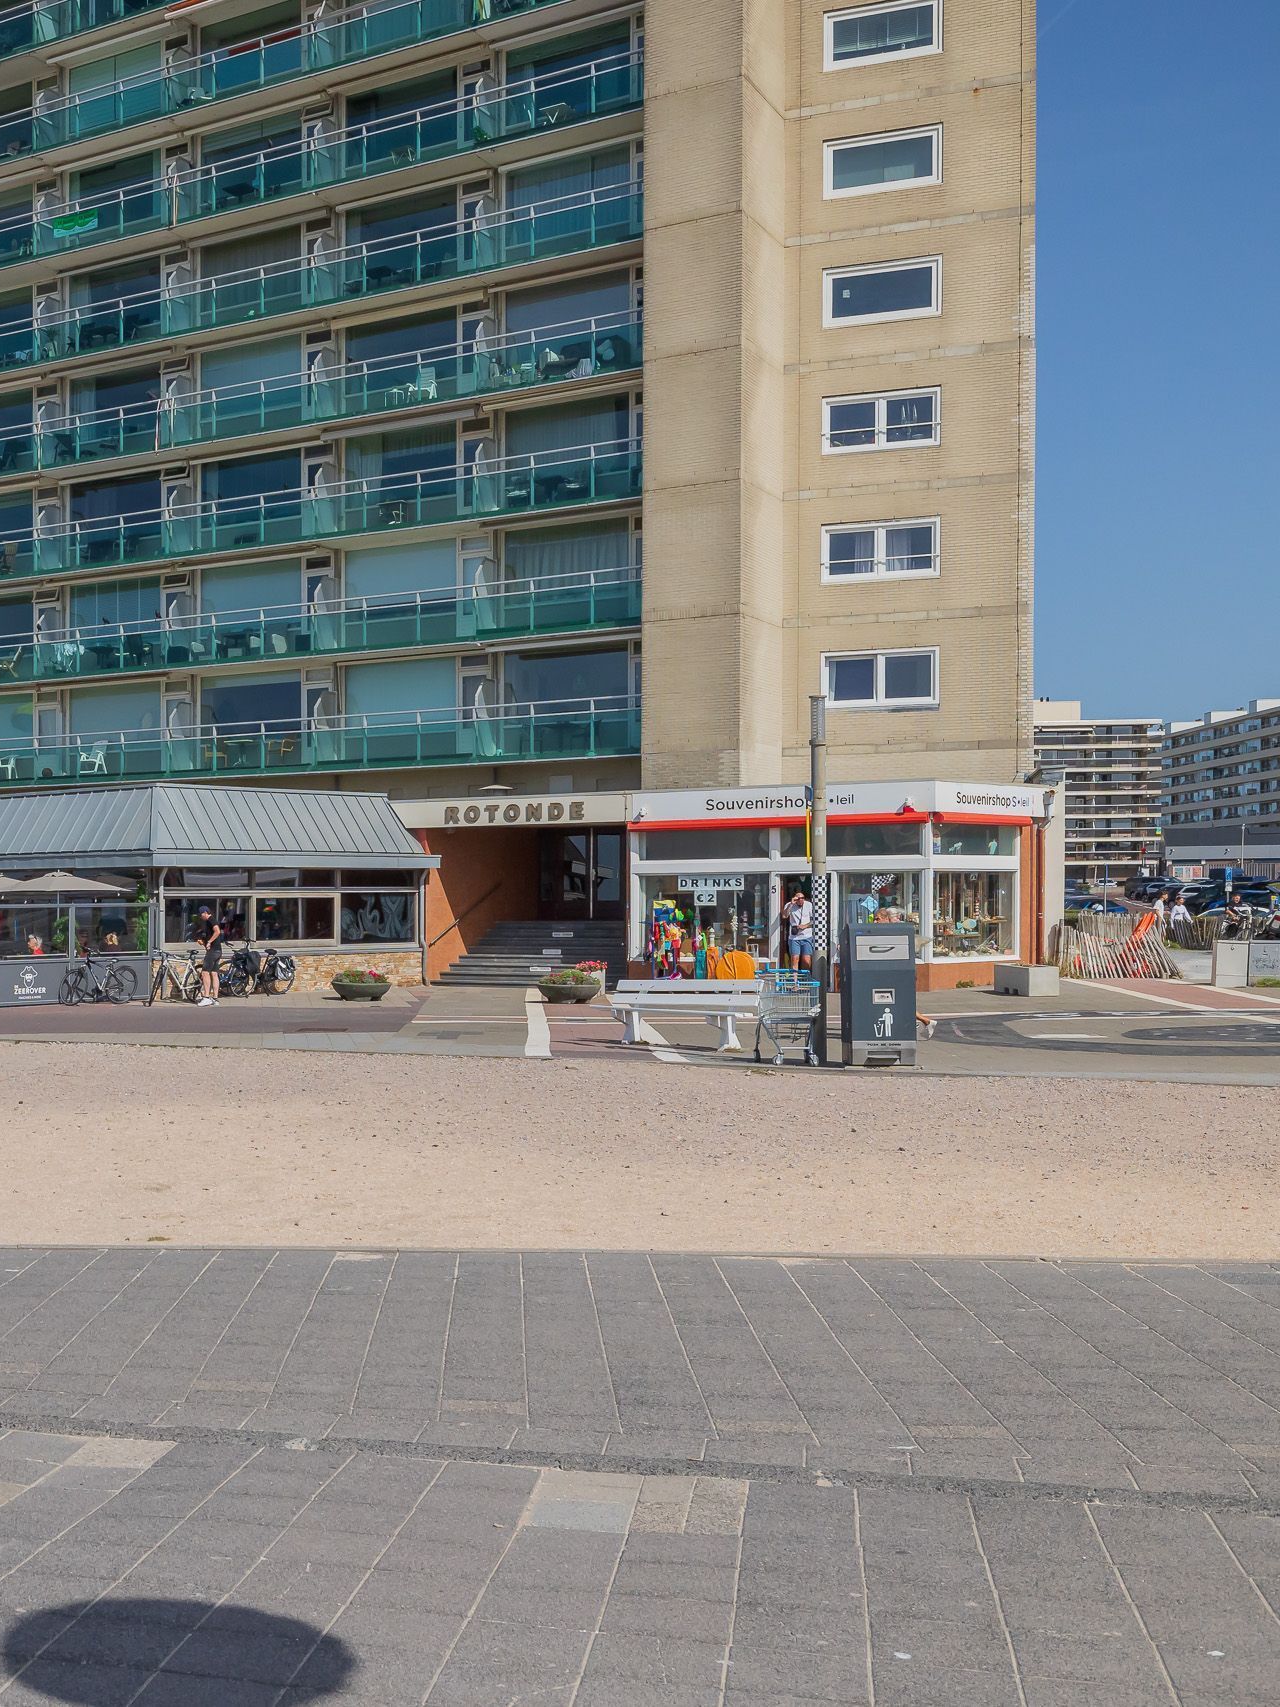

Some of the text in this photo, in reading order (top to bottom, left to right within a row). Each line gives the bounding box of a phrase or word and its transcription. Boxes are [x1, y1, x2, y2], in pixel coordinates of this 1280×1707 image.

[956, 791, 1011, 809] Souvenirshop
[444, 801, 585, 825] ROTONDE
[680, 878, 742, 888] DRINKS
[771, 885, 777, 894] 5
[13, 987, 47, 995] ZEEROVER
